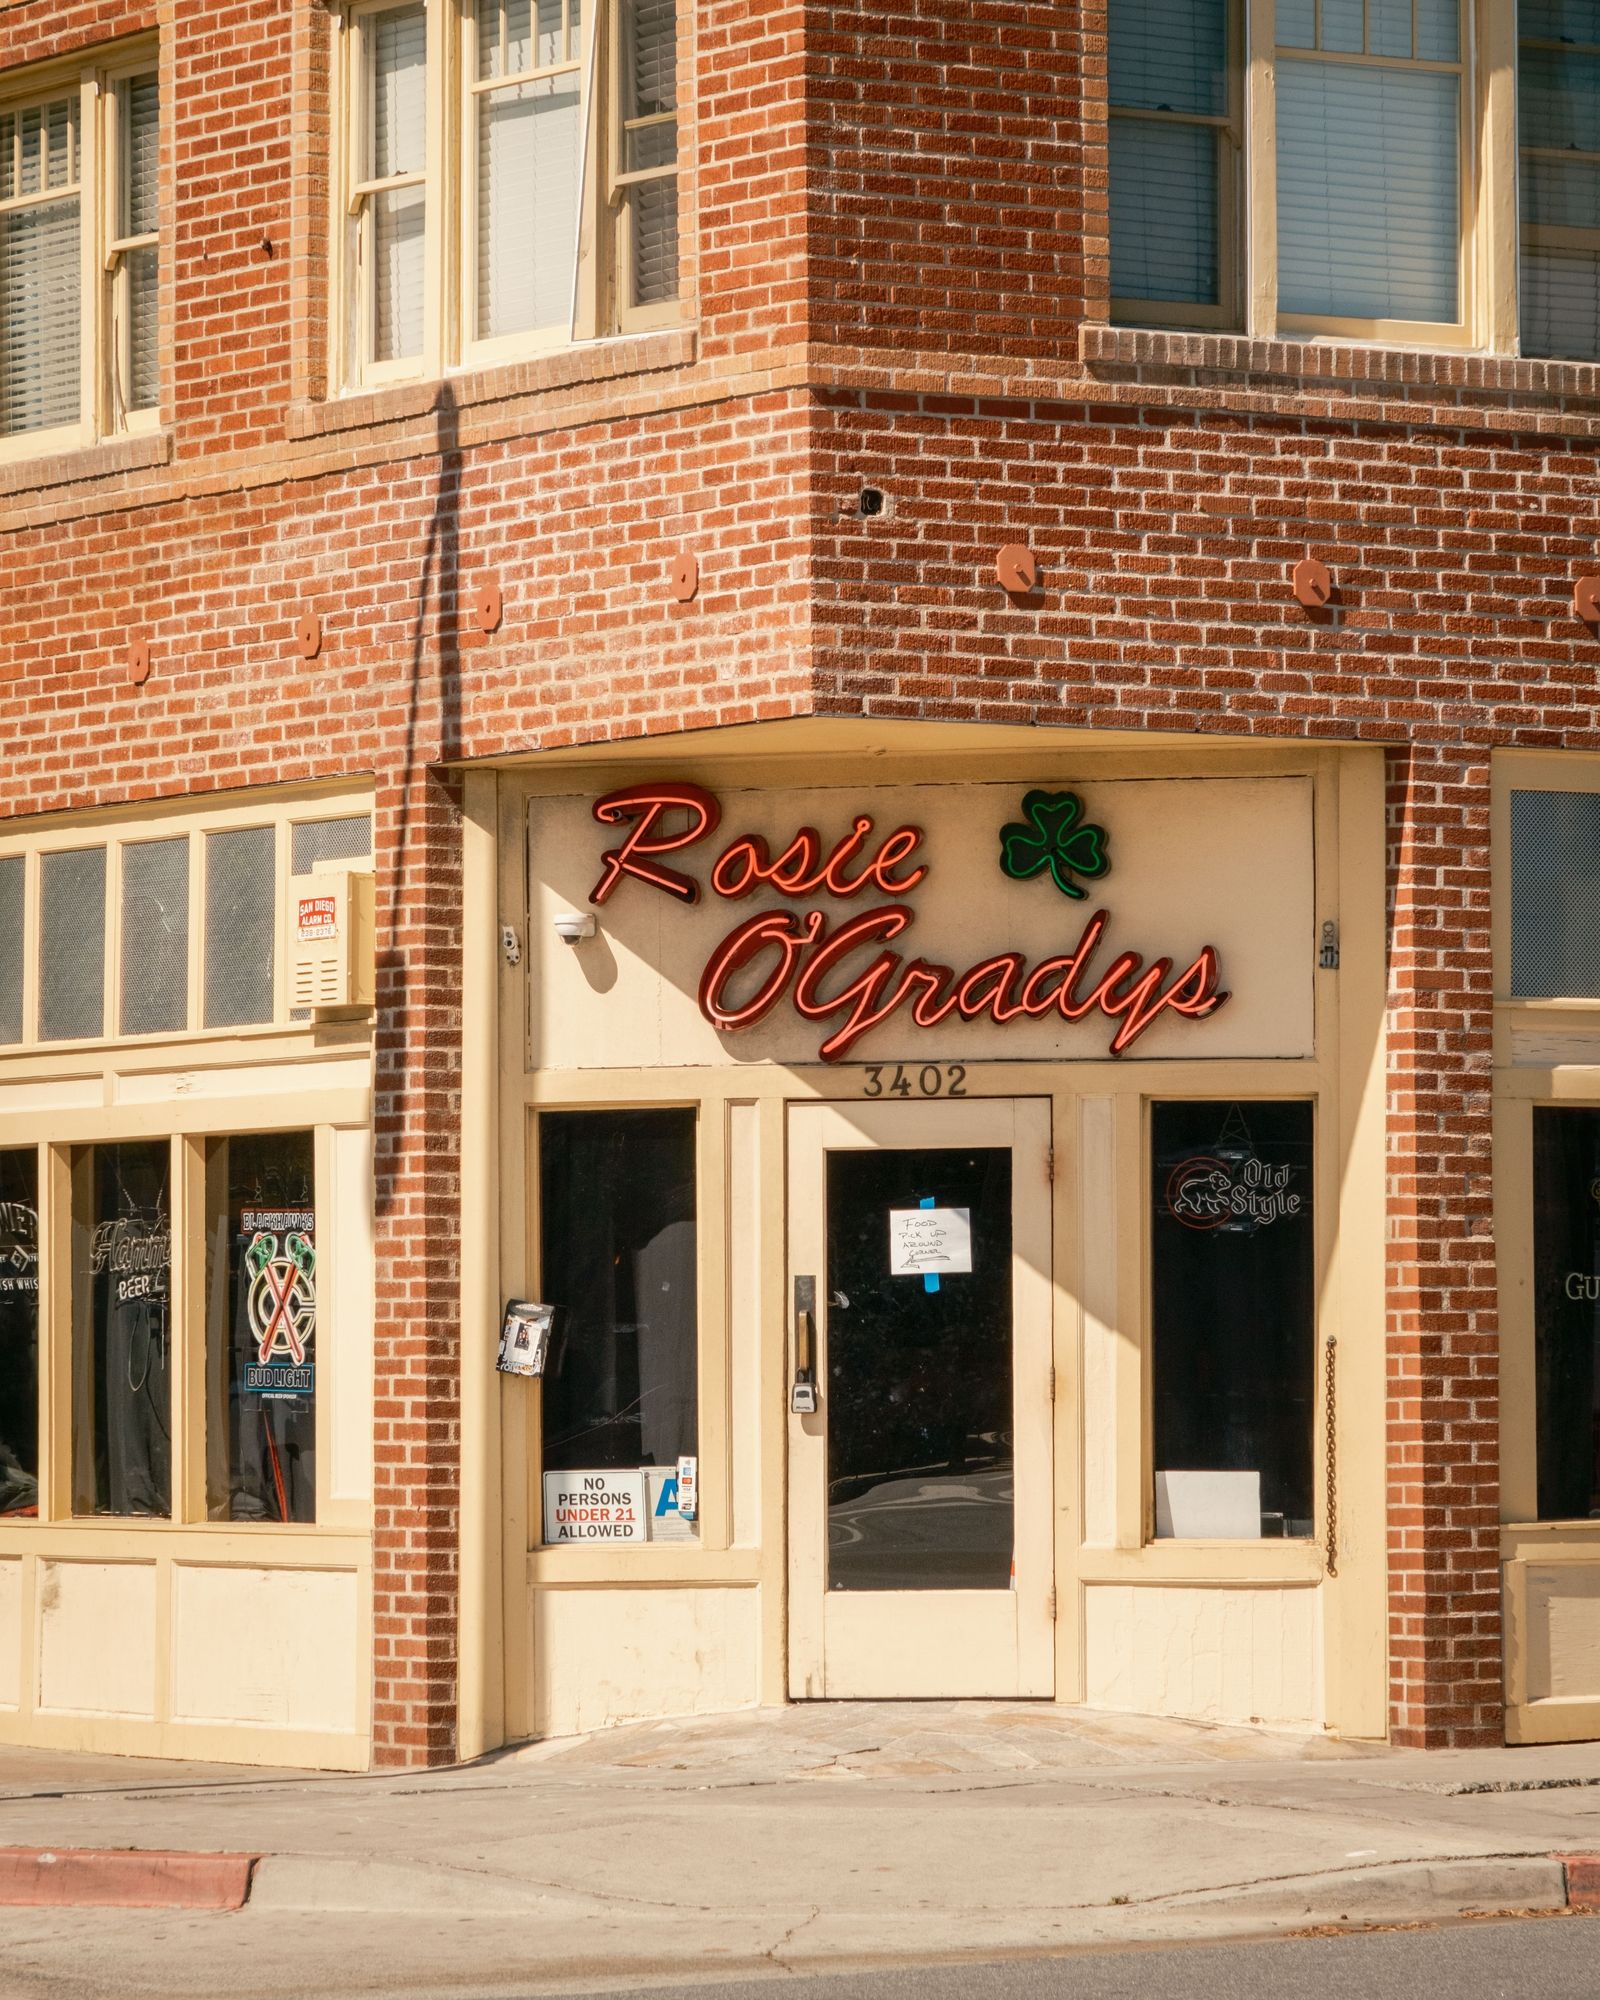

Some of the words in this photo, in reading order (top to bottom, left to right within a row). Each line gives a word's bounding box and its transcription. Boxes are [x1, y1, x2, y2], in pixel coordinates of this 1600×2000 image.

[590, 782, 929, 904] Rosie
[300, 902, 314, 917] SAN
[314, 899, 335, 913] DIEGO
[302, 914, 323, 926] ALARM
[700, 904, 1231, 1062] O'Gradys
[864, 1065, 967, 1097] 3402
[1244, 1158, 1290, 1188] Old
[1231, 1185, 1301, 1225] Style
[242, 1212, 315, 1231] BLACKHAWKS
[903, 1217, 938, 1231] FOOD
[929, 1229, 947, 1238] UP
[903, 1239, 944, 1249] AROUND
[247, 1367, 273, 1387] BUD
[273, 1368, 311, 1388] LIGHT
[584, 1477, 605, 1490] NO
[558, 1492, 632, 1506] PERSONS
[555, 1508, 610, 1522] UNDER
[615, 1507, 636, 1521] 21
[558, 1524, 634, 1539] ALLOWED
